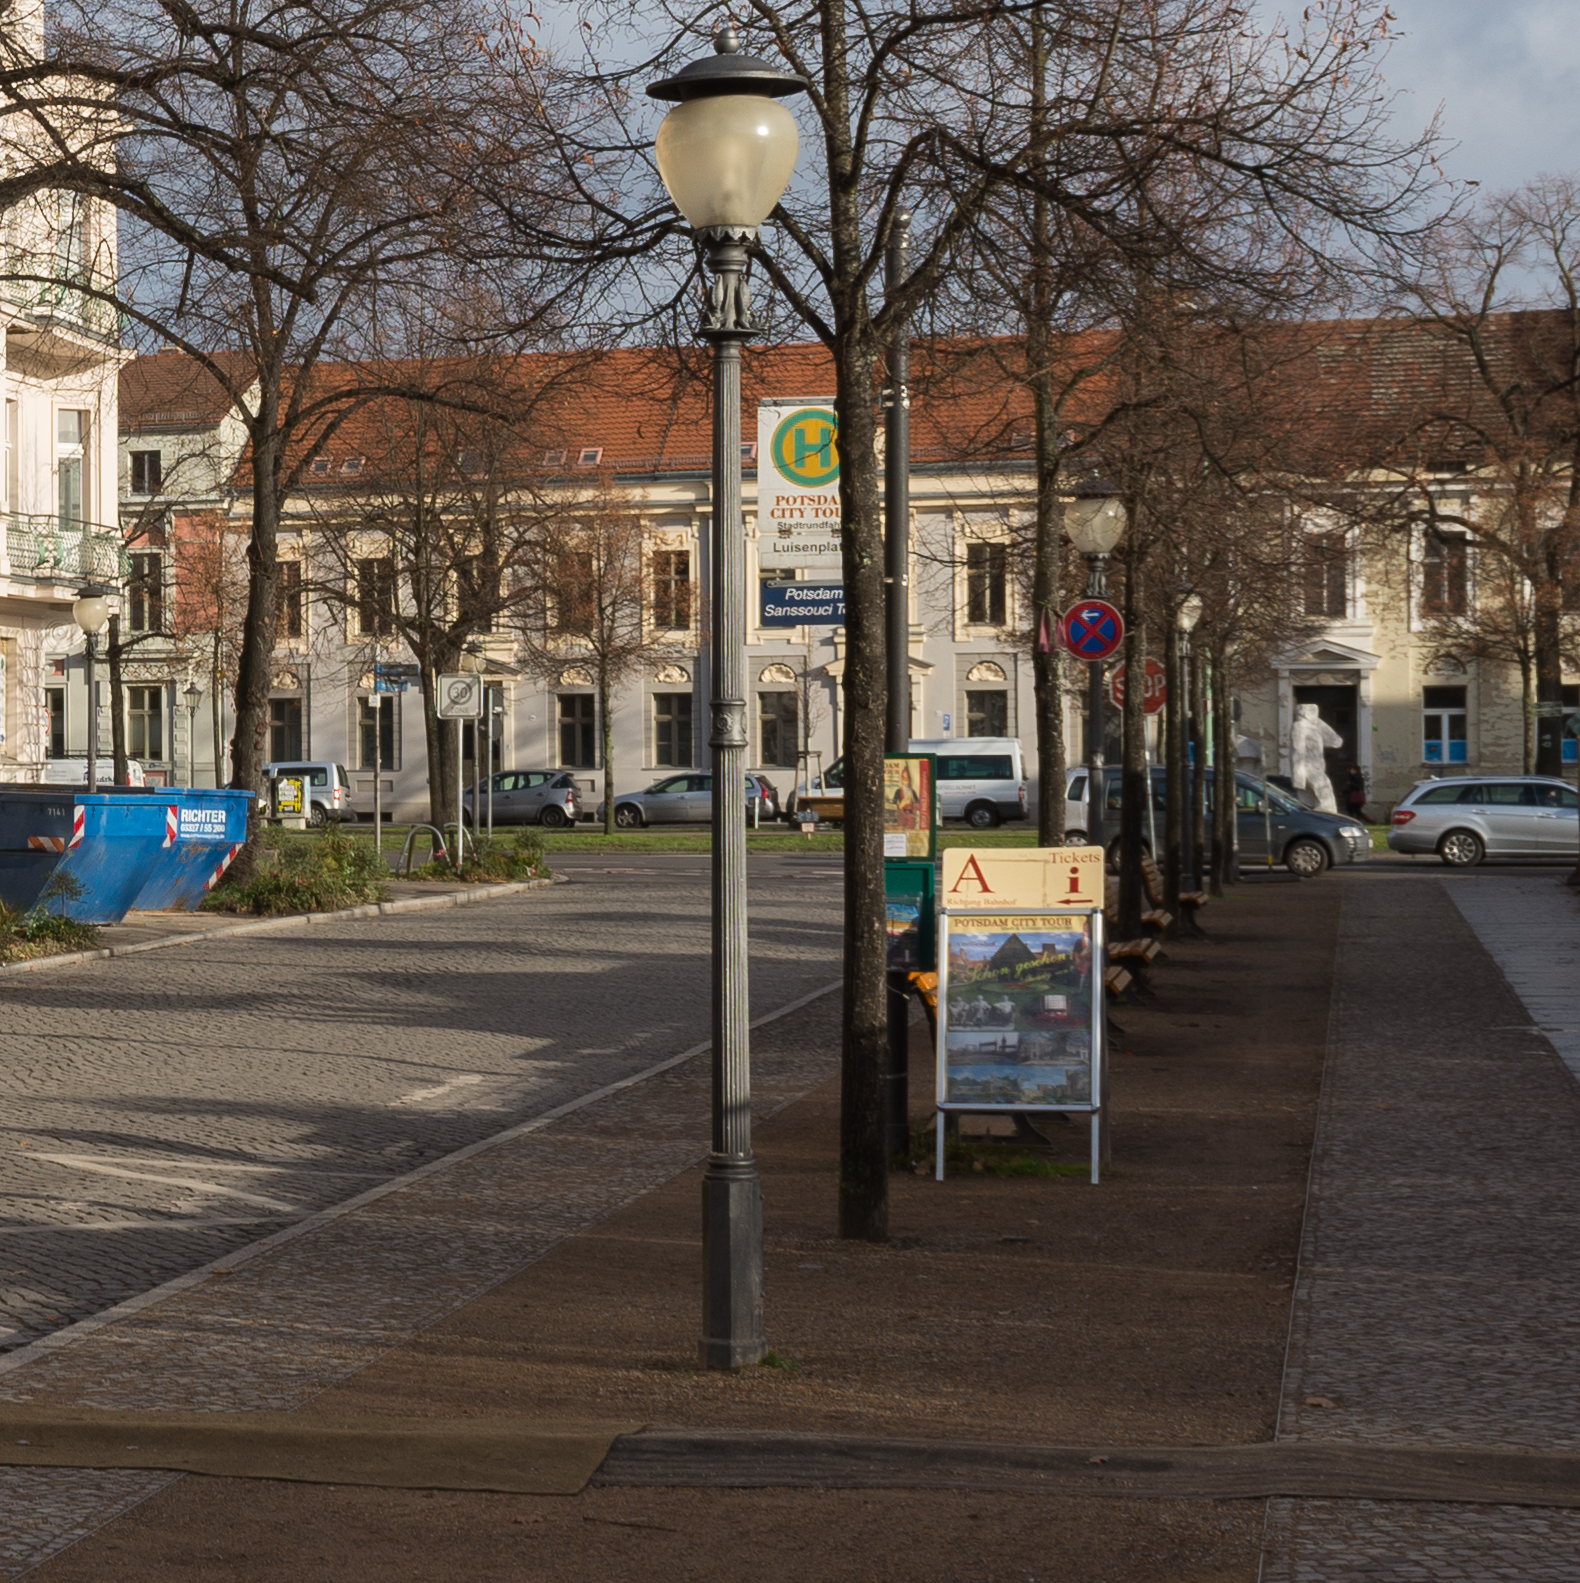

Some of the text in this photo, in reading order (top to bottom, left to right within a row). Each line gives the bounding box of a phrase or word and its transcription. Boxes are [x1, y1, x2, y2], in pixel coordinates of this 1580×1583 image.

[794, 427, 831, 468] H
[775, 494, 840, 507] POTSDA
[770, 507, 807, 519] CITY
[778, 521, 841, 530] Stadtrundfah
[773, 541, 842, 554] Luisenpla
[785, 588, 844, 600] Potsdam
[764, 603, 833, 617] Sanssouci
[452, 687, 467, 699] 30
[1115, 674, 1166, 699] SOP
[180, 809, 227, 823] RICHTER
[1049, 852, 1101, 864] Tickets
[947, 853, 995, 893] A
[954, 918, 1072, 928] POTSDAM CITY TOUR
